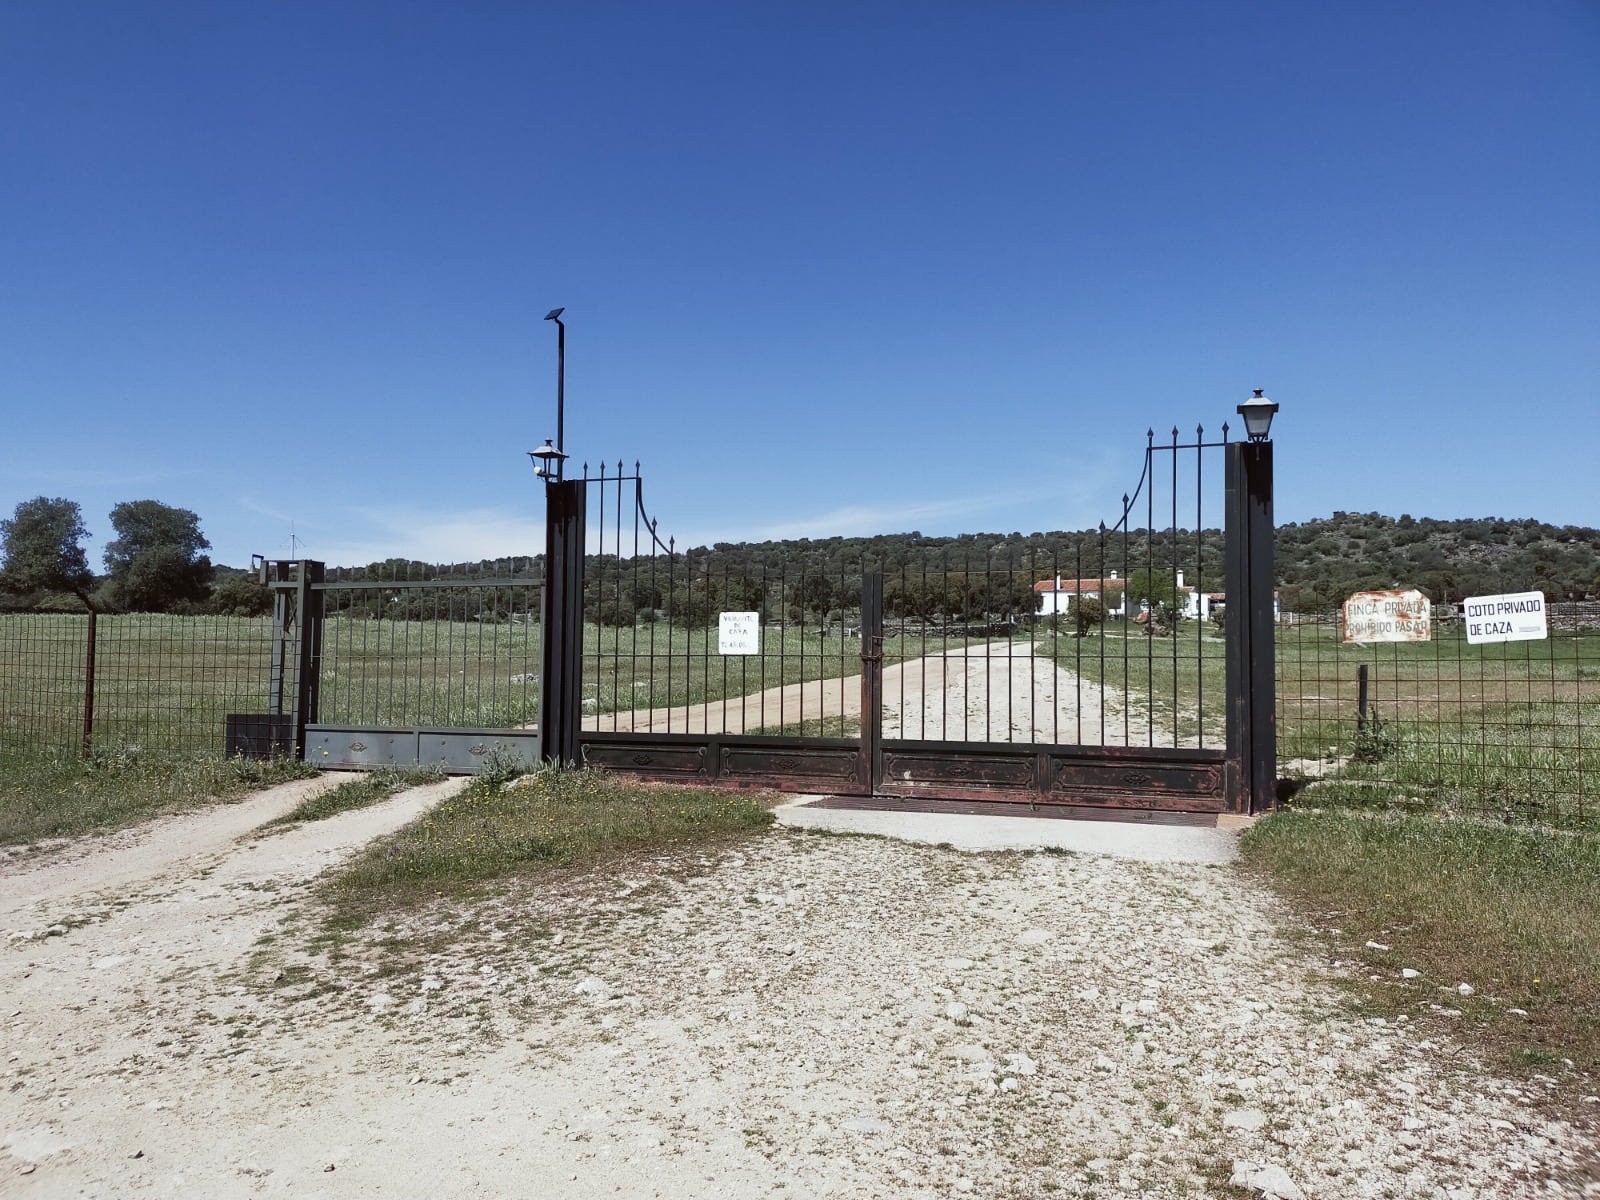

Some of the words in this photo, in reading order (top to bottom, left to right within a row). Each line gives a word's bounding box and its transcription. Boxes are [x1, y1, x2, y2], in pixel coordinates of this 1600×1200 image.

[1347, 602, 1378, 616] FINCA
[1385, 601, 1427, 615] PRIVADA
[1468, 604, 1495, 617] COTO
[1497, 599, 1541, 615] PRIVADO
[1395, 619, 1427, 633] PASAR
[1470, 623, 1482, 635] DE
[1485, 621, 1513, 635] CAZA
